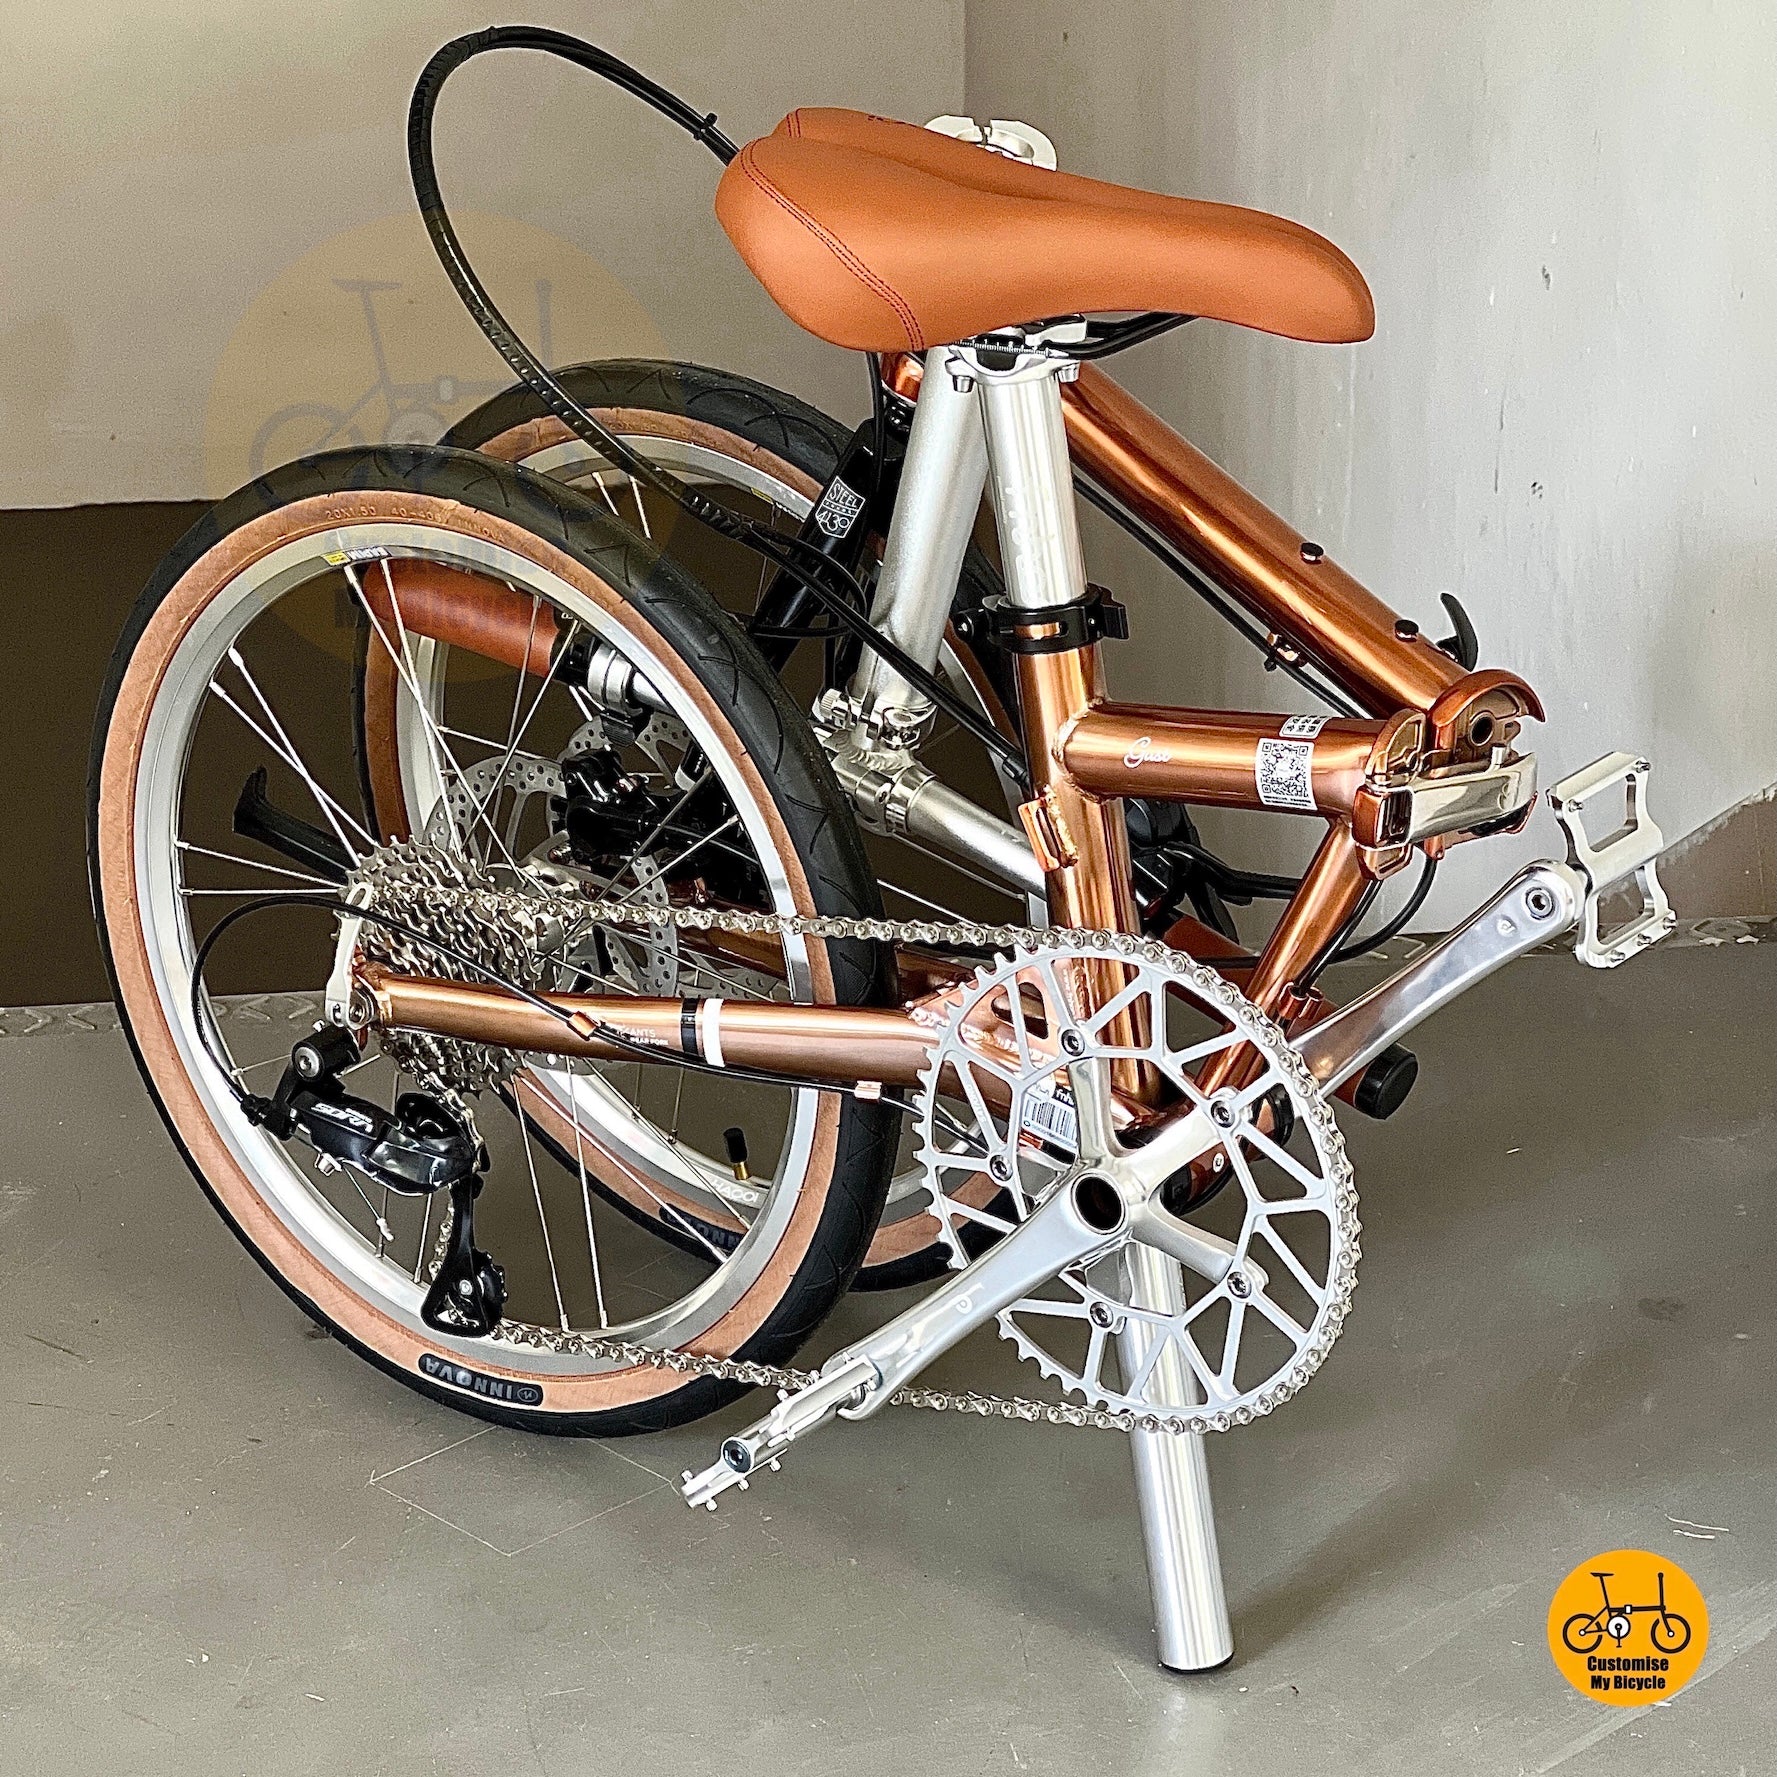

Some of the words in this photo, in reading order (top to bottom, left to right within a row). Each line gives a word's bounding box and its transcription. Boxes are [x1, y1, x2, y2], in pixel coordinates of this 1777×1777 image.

[829, 482, 858, 508] STEEL
[817, 510, 851, 532] 4130
[311, 1102, 374, 1133] SORA
[424, 1357, 513, 1400] INNOVA
